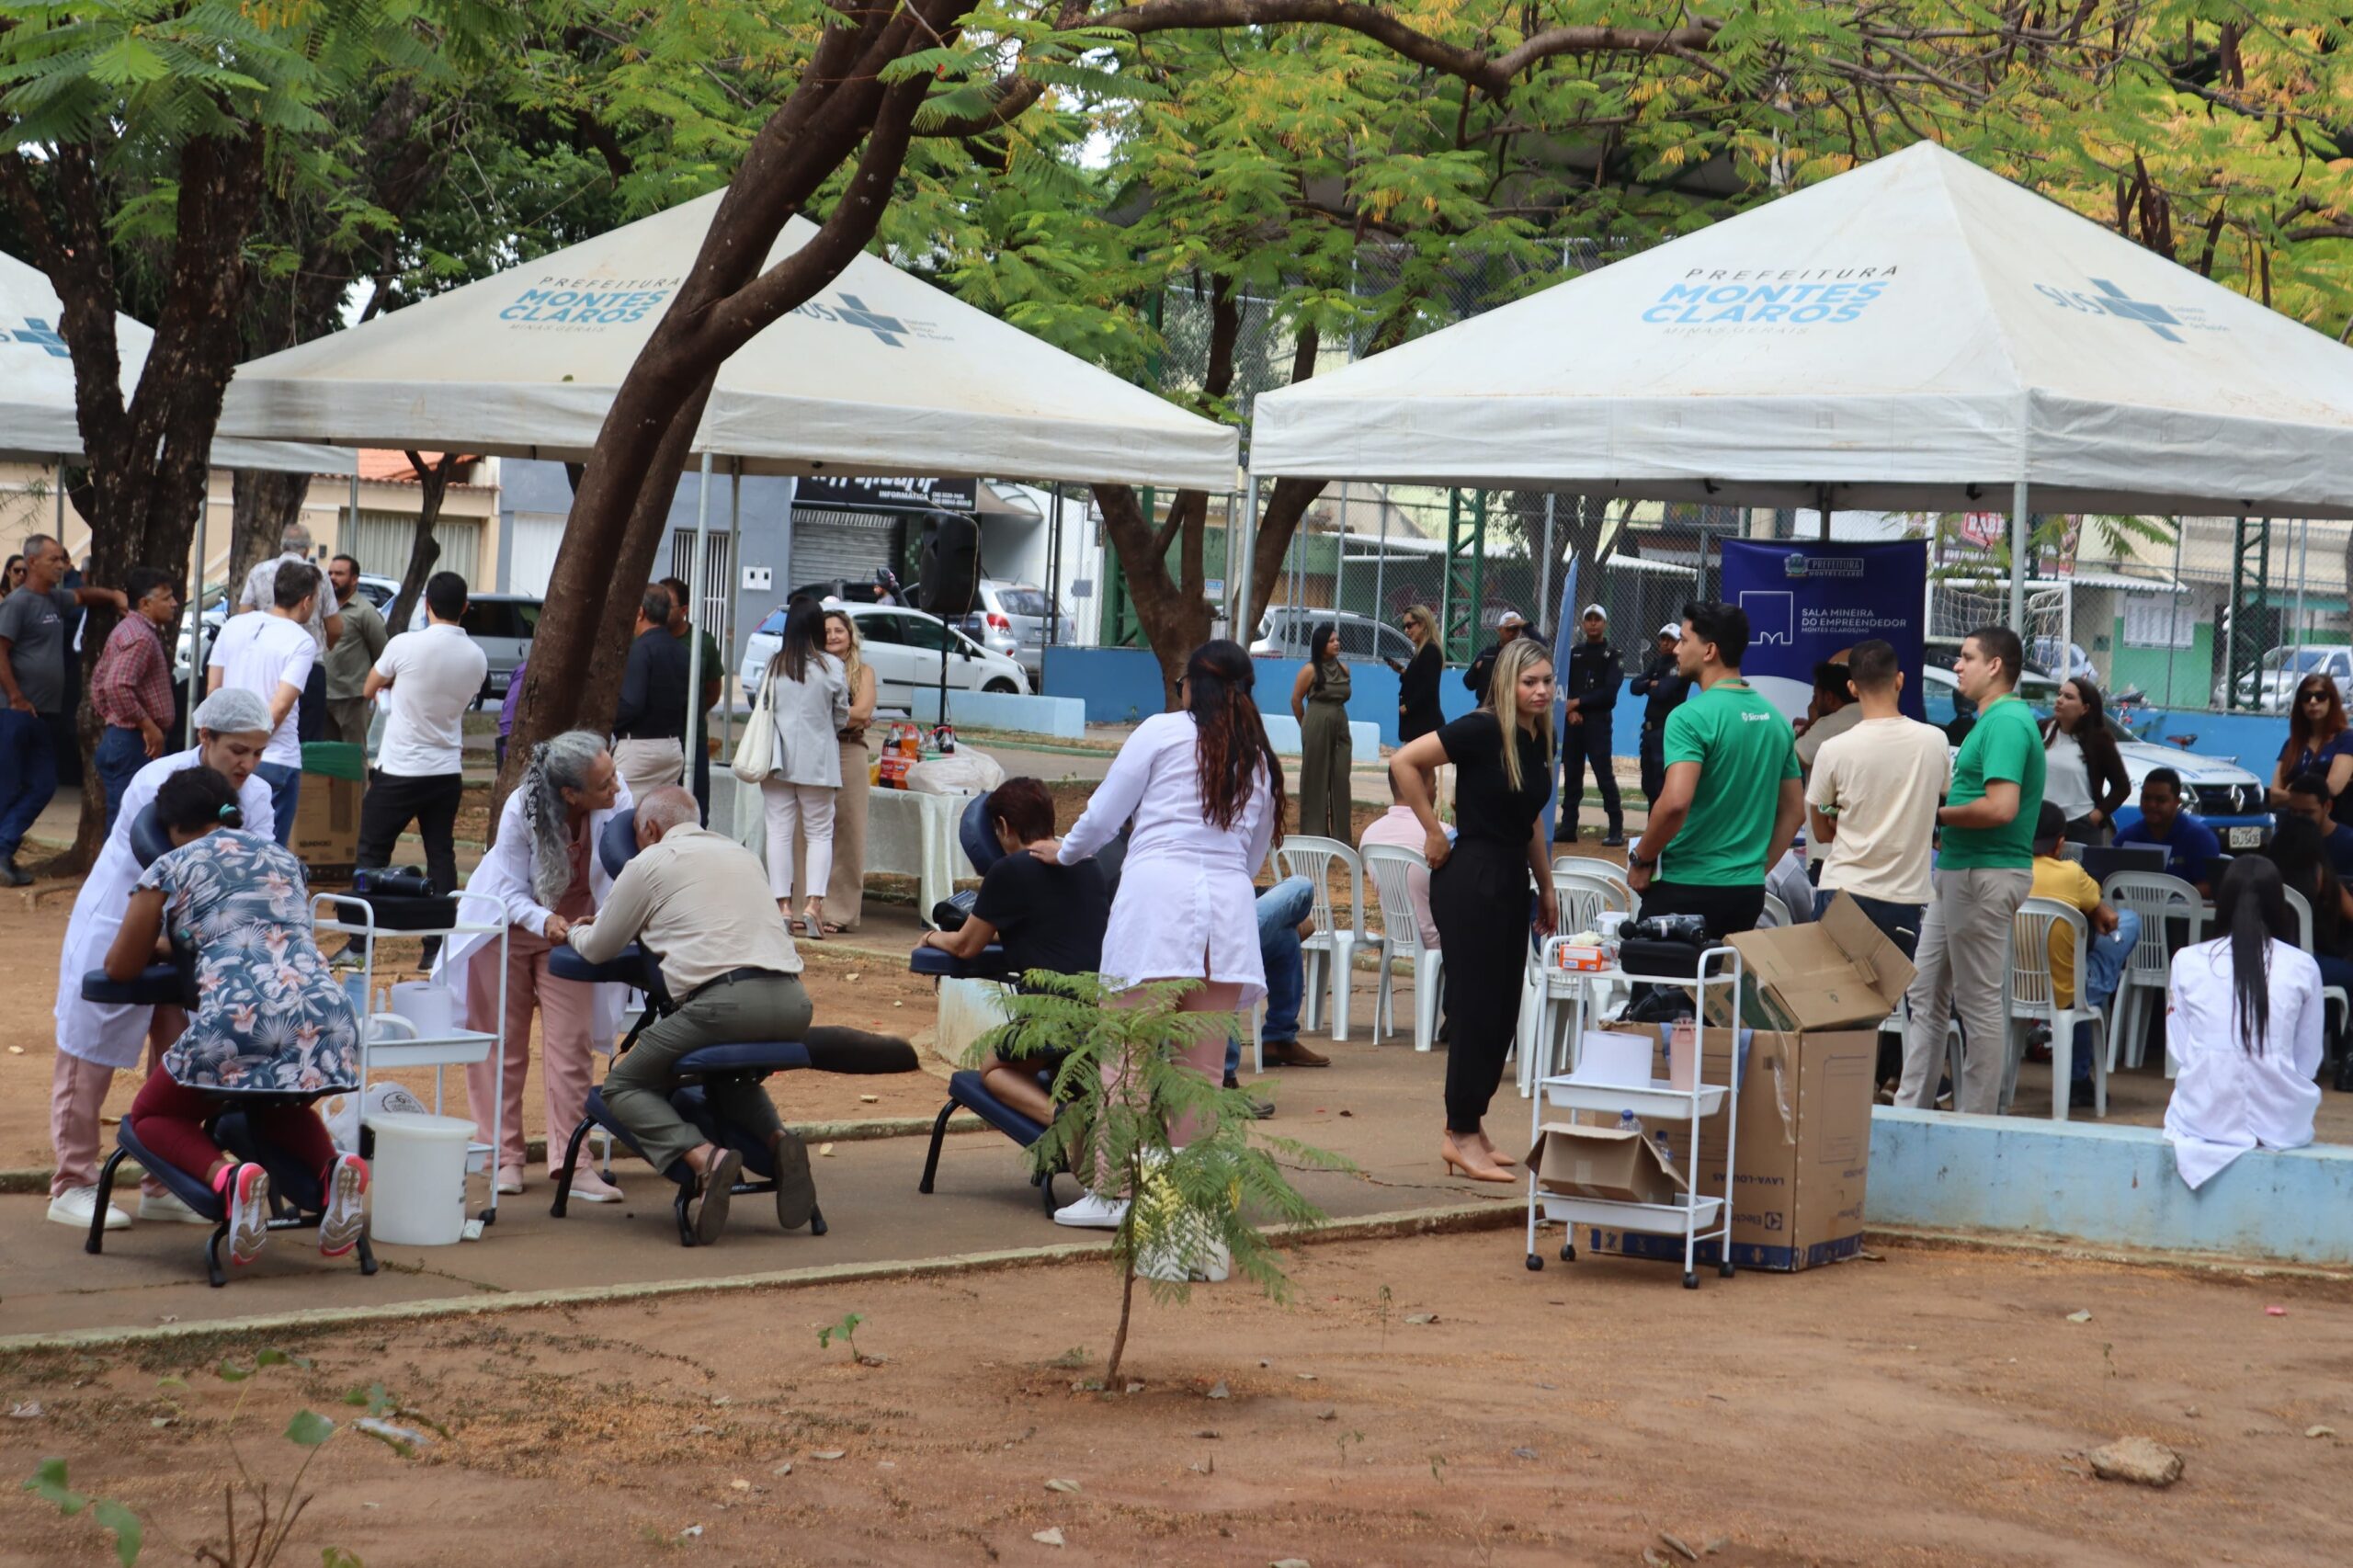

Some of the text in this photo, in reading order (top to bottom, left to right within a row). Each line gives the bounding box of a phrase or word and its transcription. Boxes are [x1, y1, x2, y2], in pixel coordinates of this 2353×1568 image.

[1685, 265, 1898, 280] PREFEITURA
[539, 277, 680, 289] PREFEITURA
[516, 289, 669, 308] MONTES
[1658, 281, 1890, 304] MONTES
[2032, 282, 2106, 315] SUS
[499, 305, 650, 324] CLAROS
[1641, 302, 1869, 324] CLAROS
[879, 490, 929, 500] INFORMÁTICA
[1813, 560, 1859, 569] PREFEITURA
[1802, 608, 1874, 617] SALA MINEIRA
[1802, 618, 1907, 628] DO EMPREENDEDOR
[1713, 1173, 1784, 1186] LAVA-LOUAS
